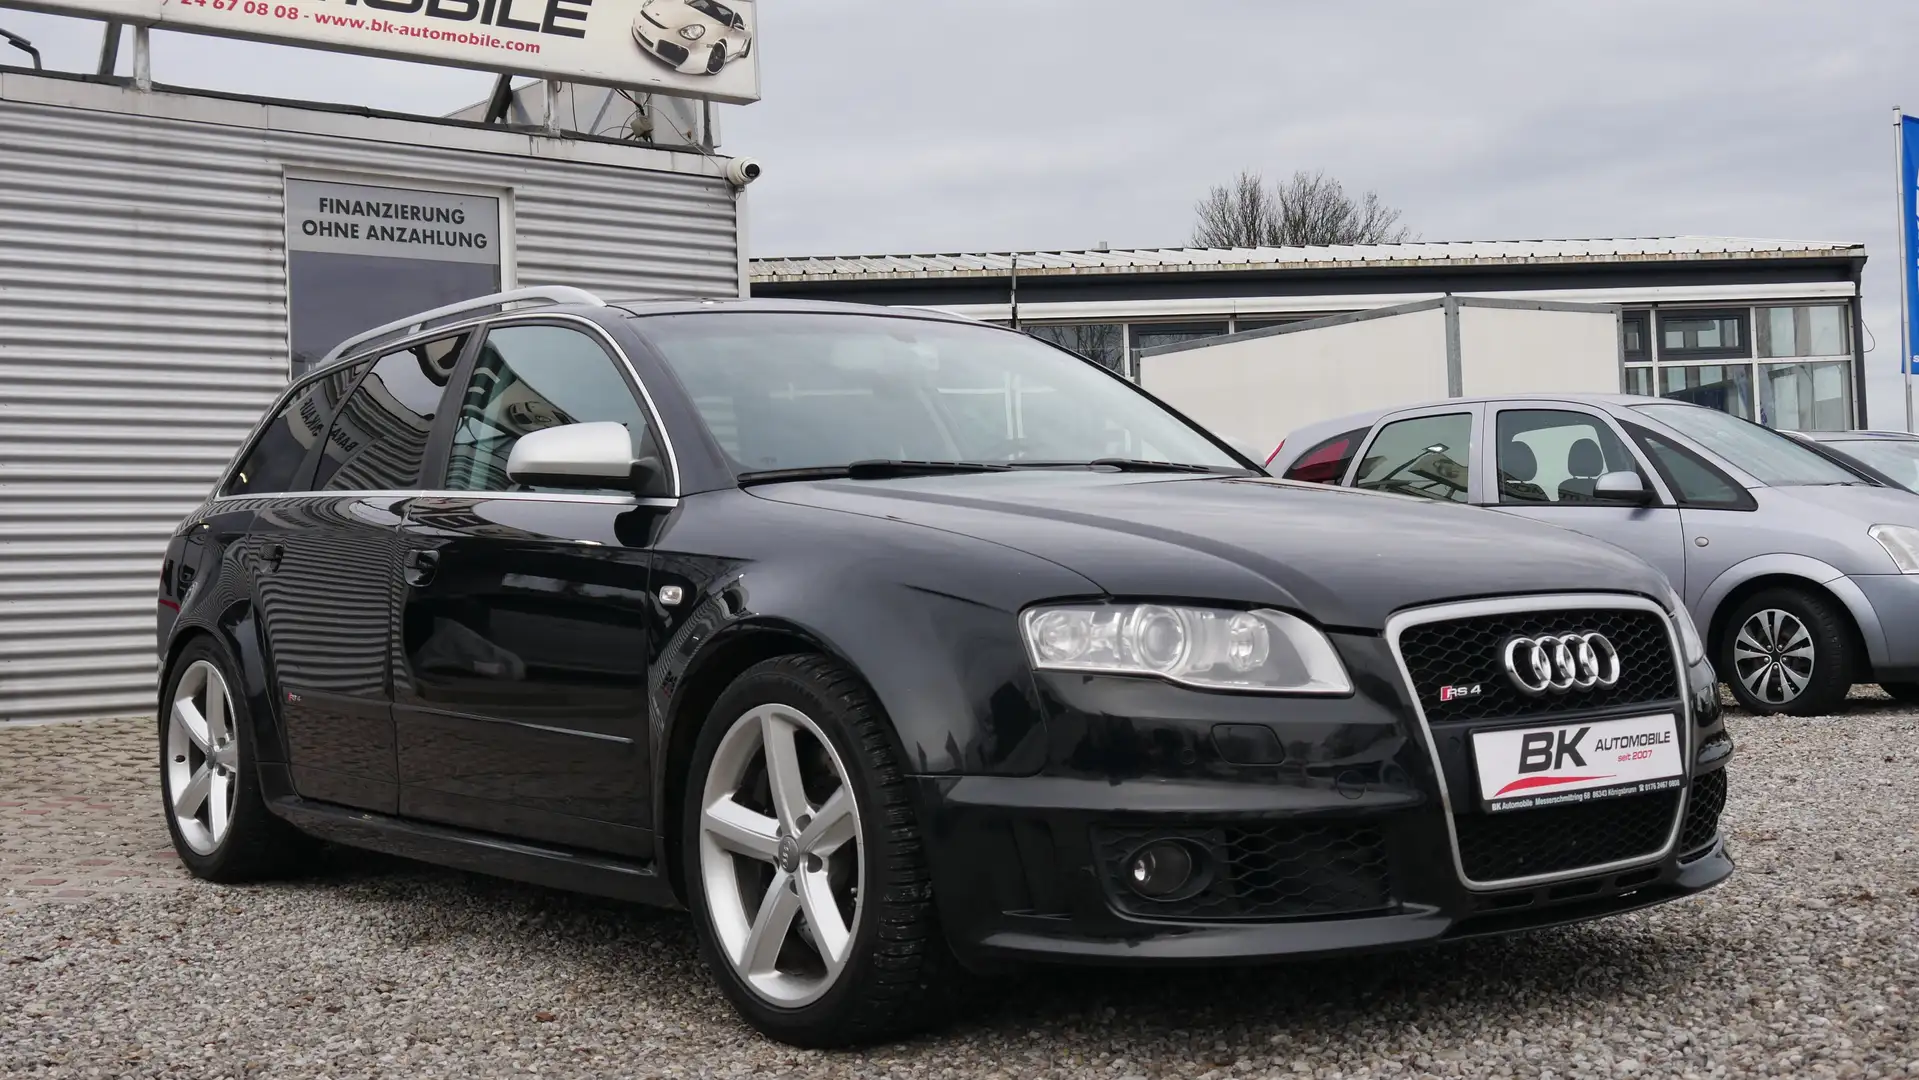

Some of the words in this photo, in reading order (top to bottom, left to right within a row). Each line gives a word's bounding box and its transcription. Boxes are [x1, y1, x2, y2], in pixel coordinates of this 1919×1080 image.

[243, 1, 269, 16] 08
[273, 5, 299, 20] 08
[314, 13, 541, 54] www.bk-automobile.com
[319, 197, 465, 225] FINANZIERUNG
[301, 219, 360, 239] OHNE
[366, 224, 487, 248] ANZAHLUNG
[1518, 727, 1591, 774] BK
[1594, 731, 1671, 752] AUTOMOBILE
[1617, 753, 1632, 763] seit
[1632, 750, 1653, 761] 2007
[1491, 802, 1501, 812] BK
[1502, 799, 1533, 810] Automobile
